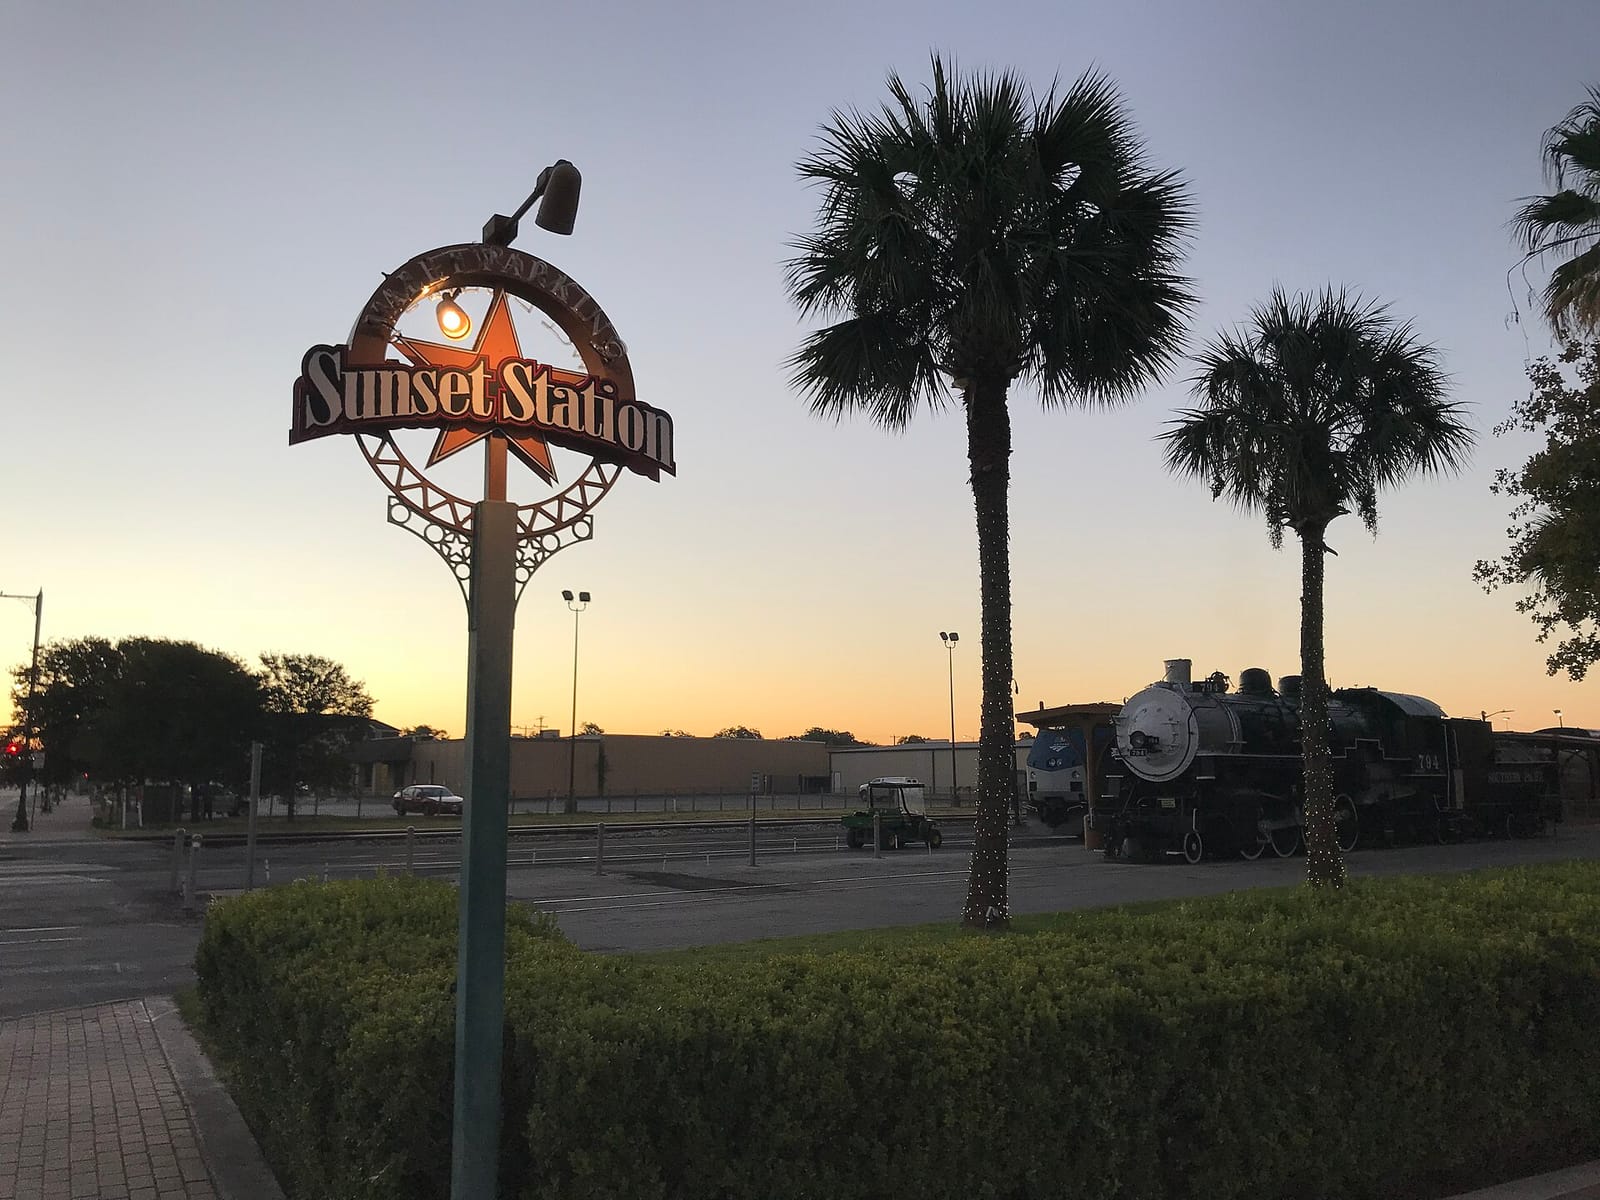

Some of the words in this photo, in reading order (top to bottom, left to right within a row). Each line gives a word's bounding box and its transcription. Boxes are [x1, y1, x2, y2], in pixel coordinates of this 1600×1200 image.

[479, 246, 627, 359] PARKING
[305, 350, 495, 429] Sunset
[501, 362, 673, 469] Station
[1418, 754, 1440, 770] 794
